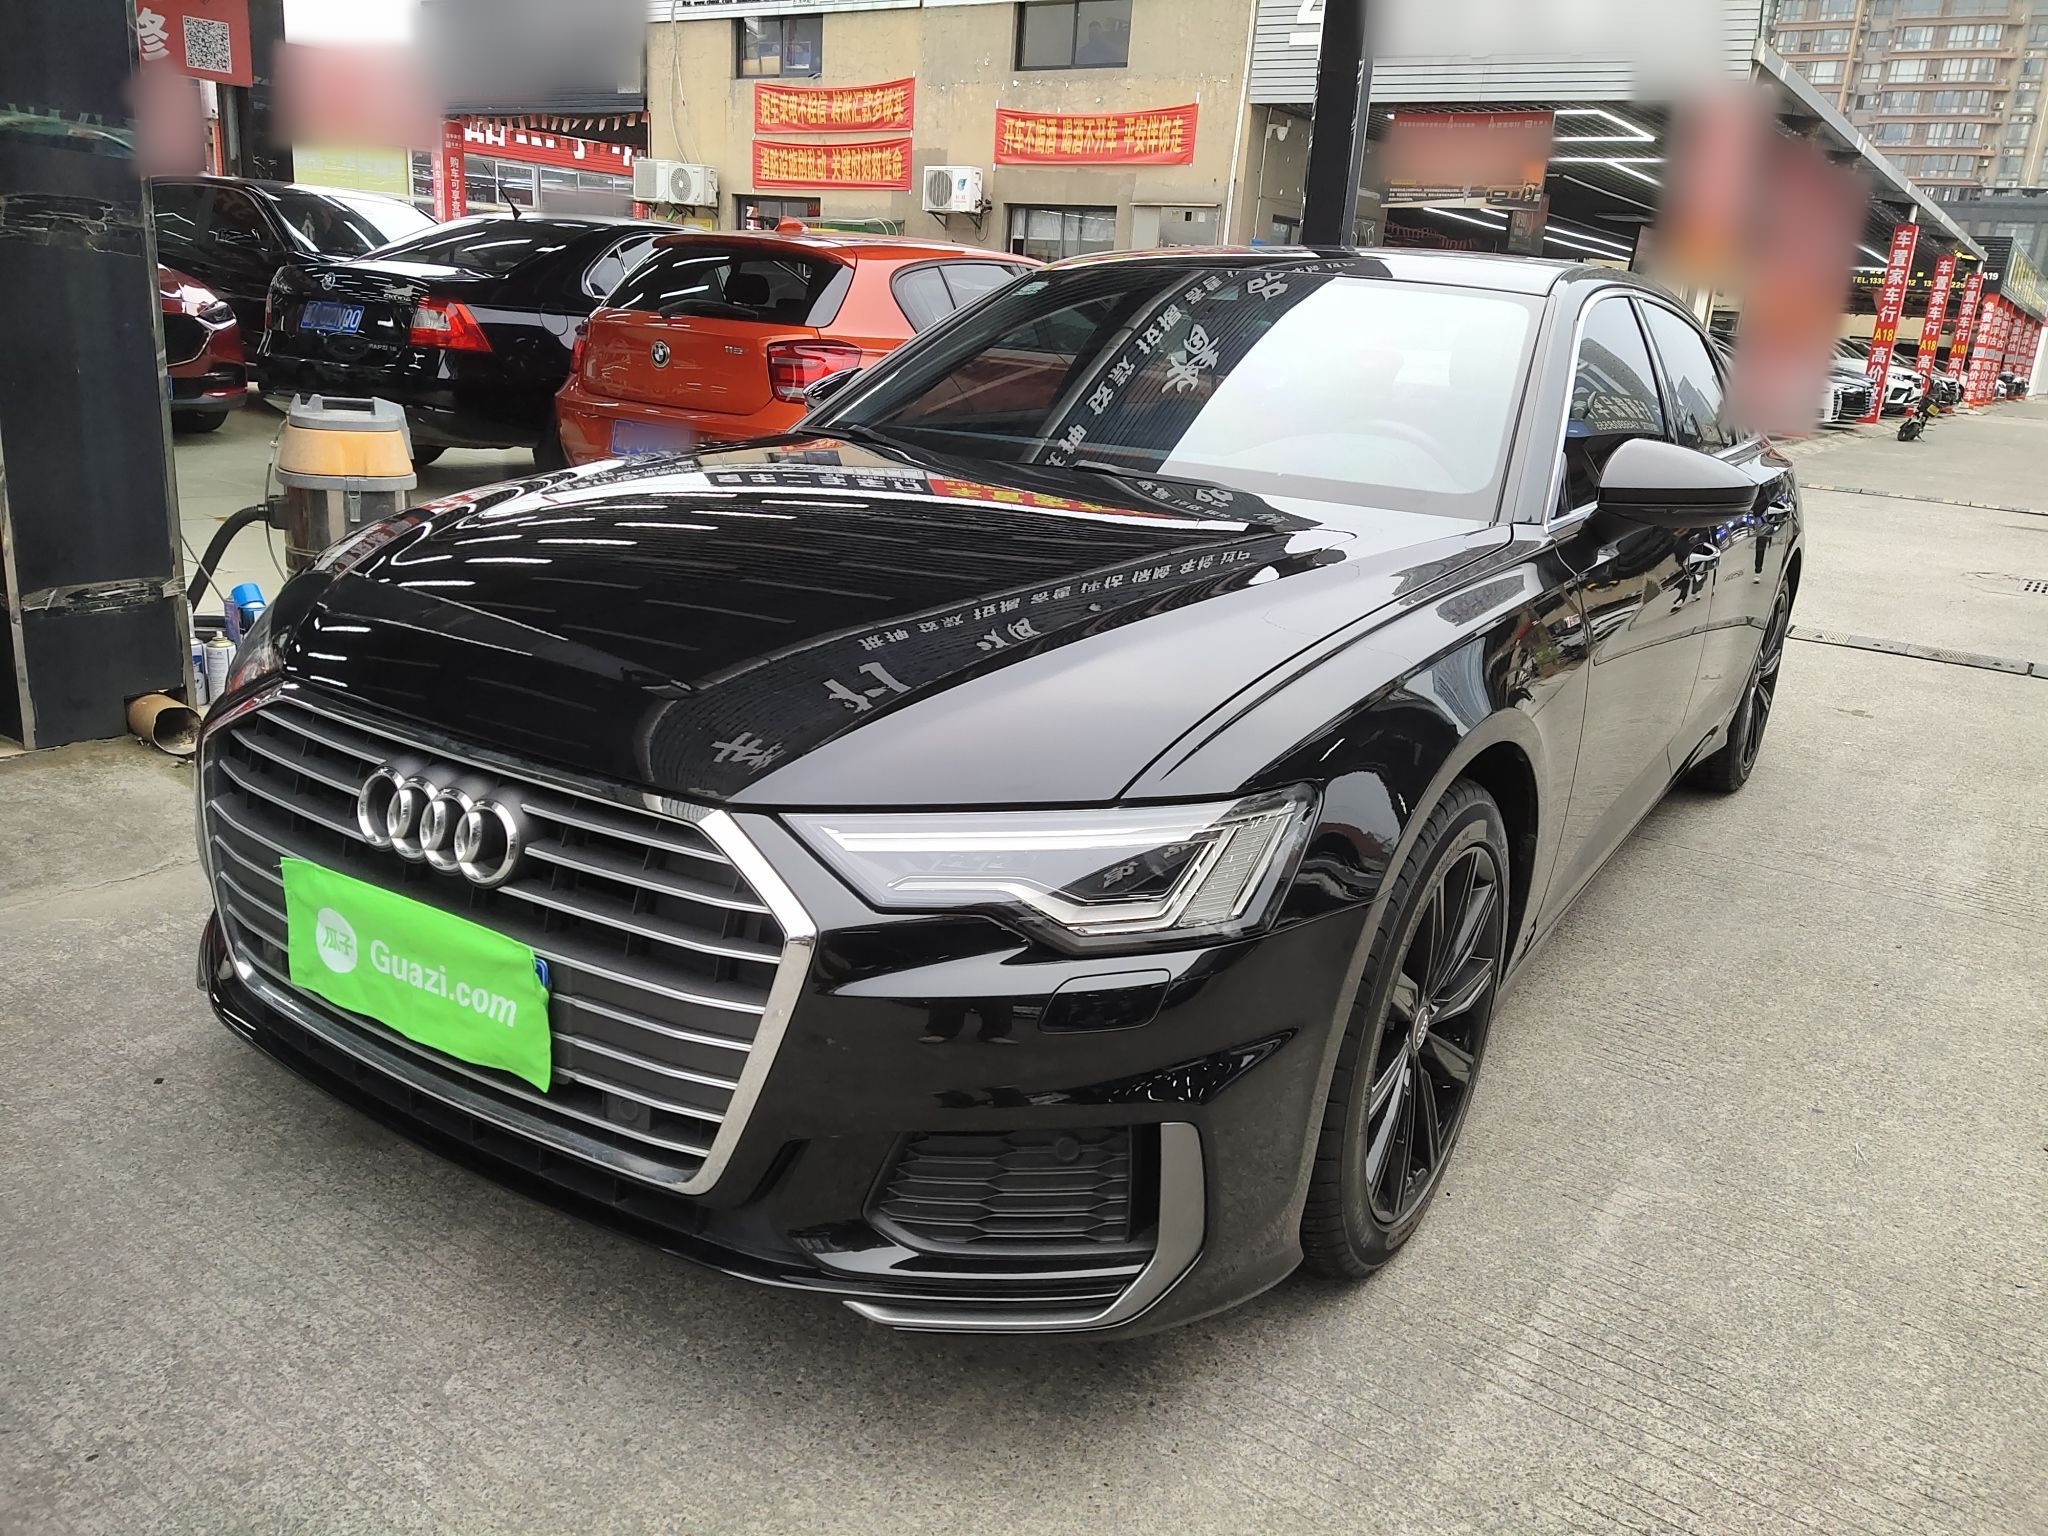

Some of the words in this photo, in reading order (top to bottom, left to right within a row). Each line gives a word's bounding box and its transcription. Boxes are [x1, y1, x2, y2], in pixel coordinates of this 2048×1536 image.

[1003, 118, 1058, 154] 开车不喝酒
[1061, 116, 1118, 154] 喝酒不开车
[1123, 114, 1184, 154] 平安伴你走
[1880, 230, 1913, 323] 车置家车行
[1924, 260, 1953, 336] 车置家车行
[1955, 277, 1980, 341] 车置家车行
[1873, 328, 1895, 342] A18
[1976, 301, 1995, 344] 免费评估
[1919, 340, 1936, 351] A18
[1951, 345, 1966, 354] A18
[1963, 360, 1982, 401] 高价收车
[370, 939, 518, 1028] Guazi.com
